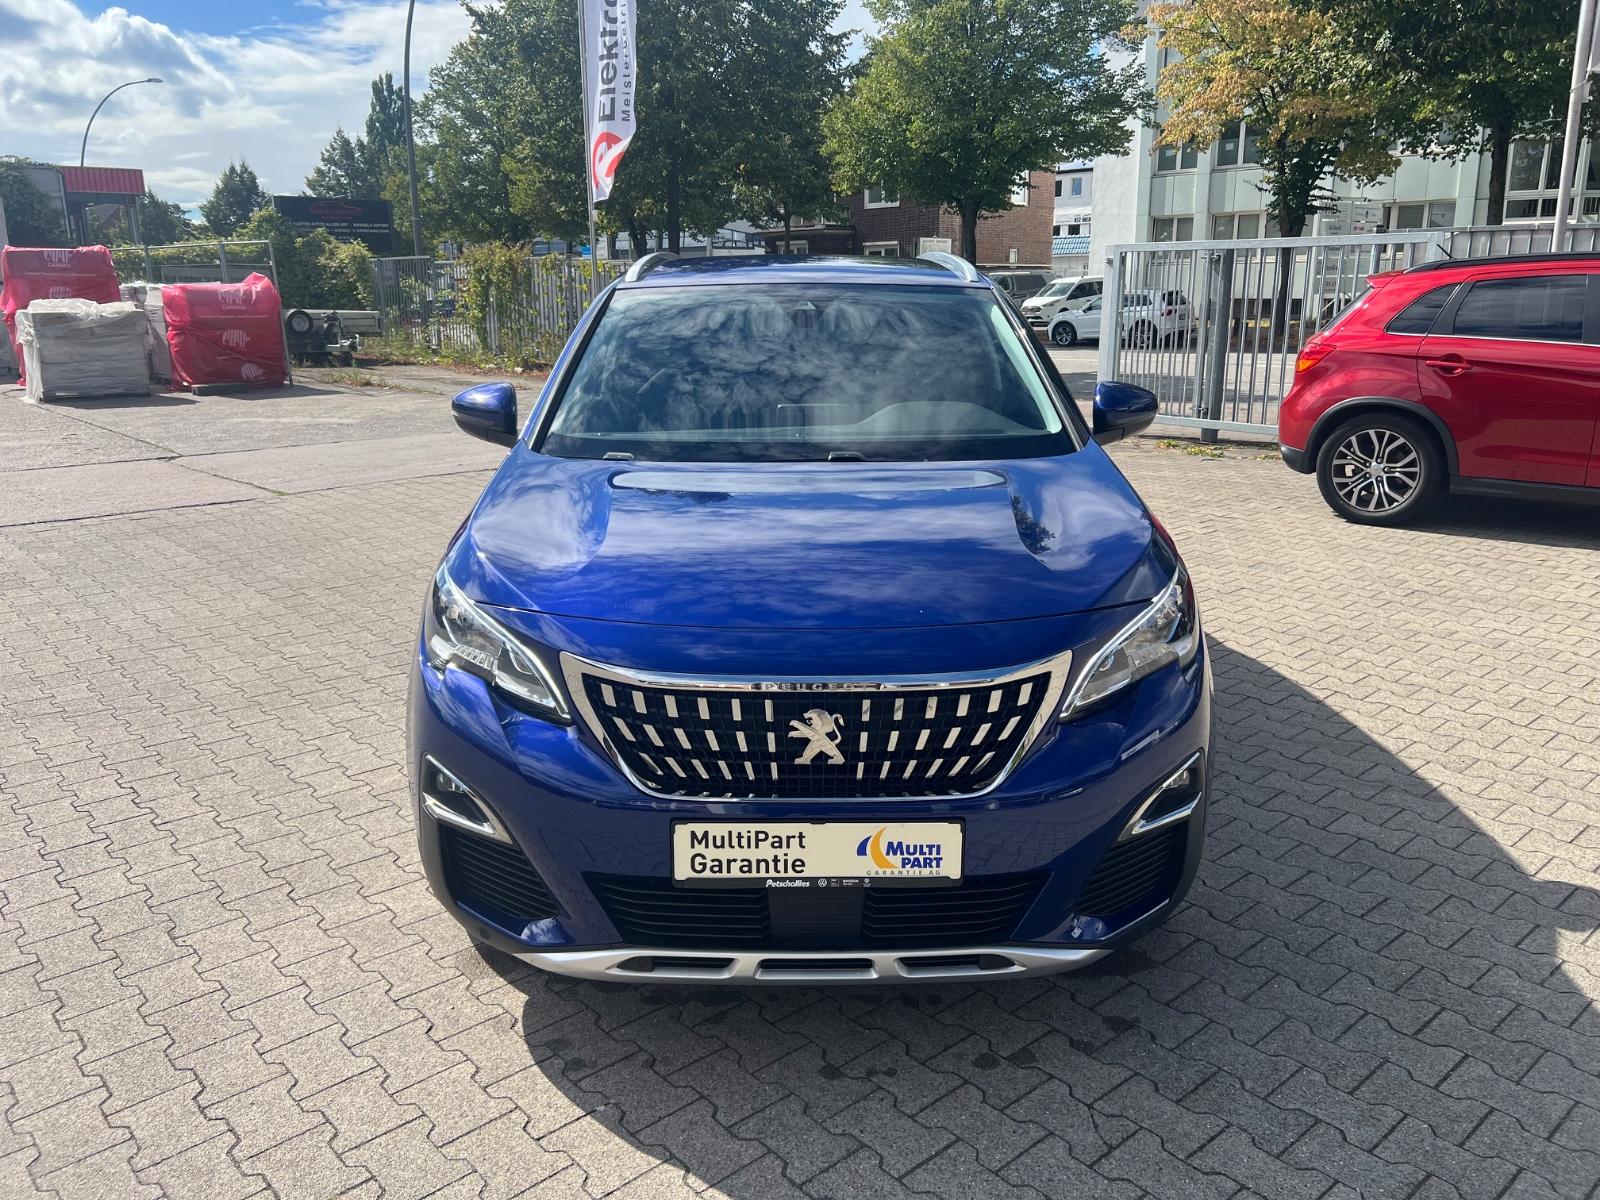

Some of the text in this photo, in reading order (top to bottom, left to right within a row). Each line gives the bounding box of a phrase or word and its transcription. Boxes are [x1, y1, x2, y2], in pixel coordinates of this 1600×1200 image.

[690, 830, 806, 849] MultiPart
[690, 852, 806, 874] Garantie
[901, 857, 943, 869] PART
[765, 879, 810, 888] Petschallies
